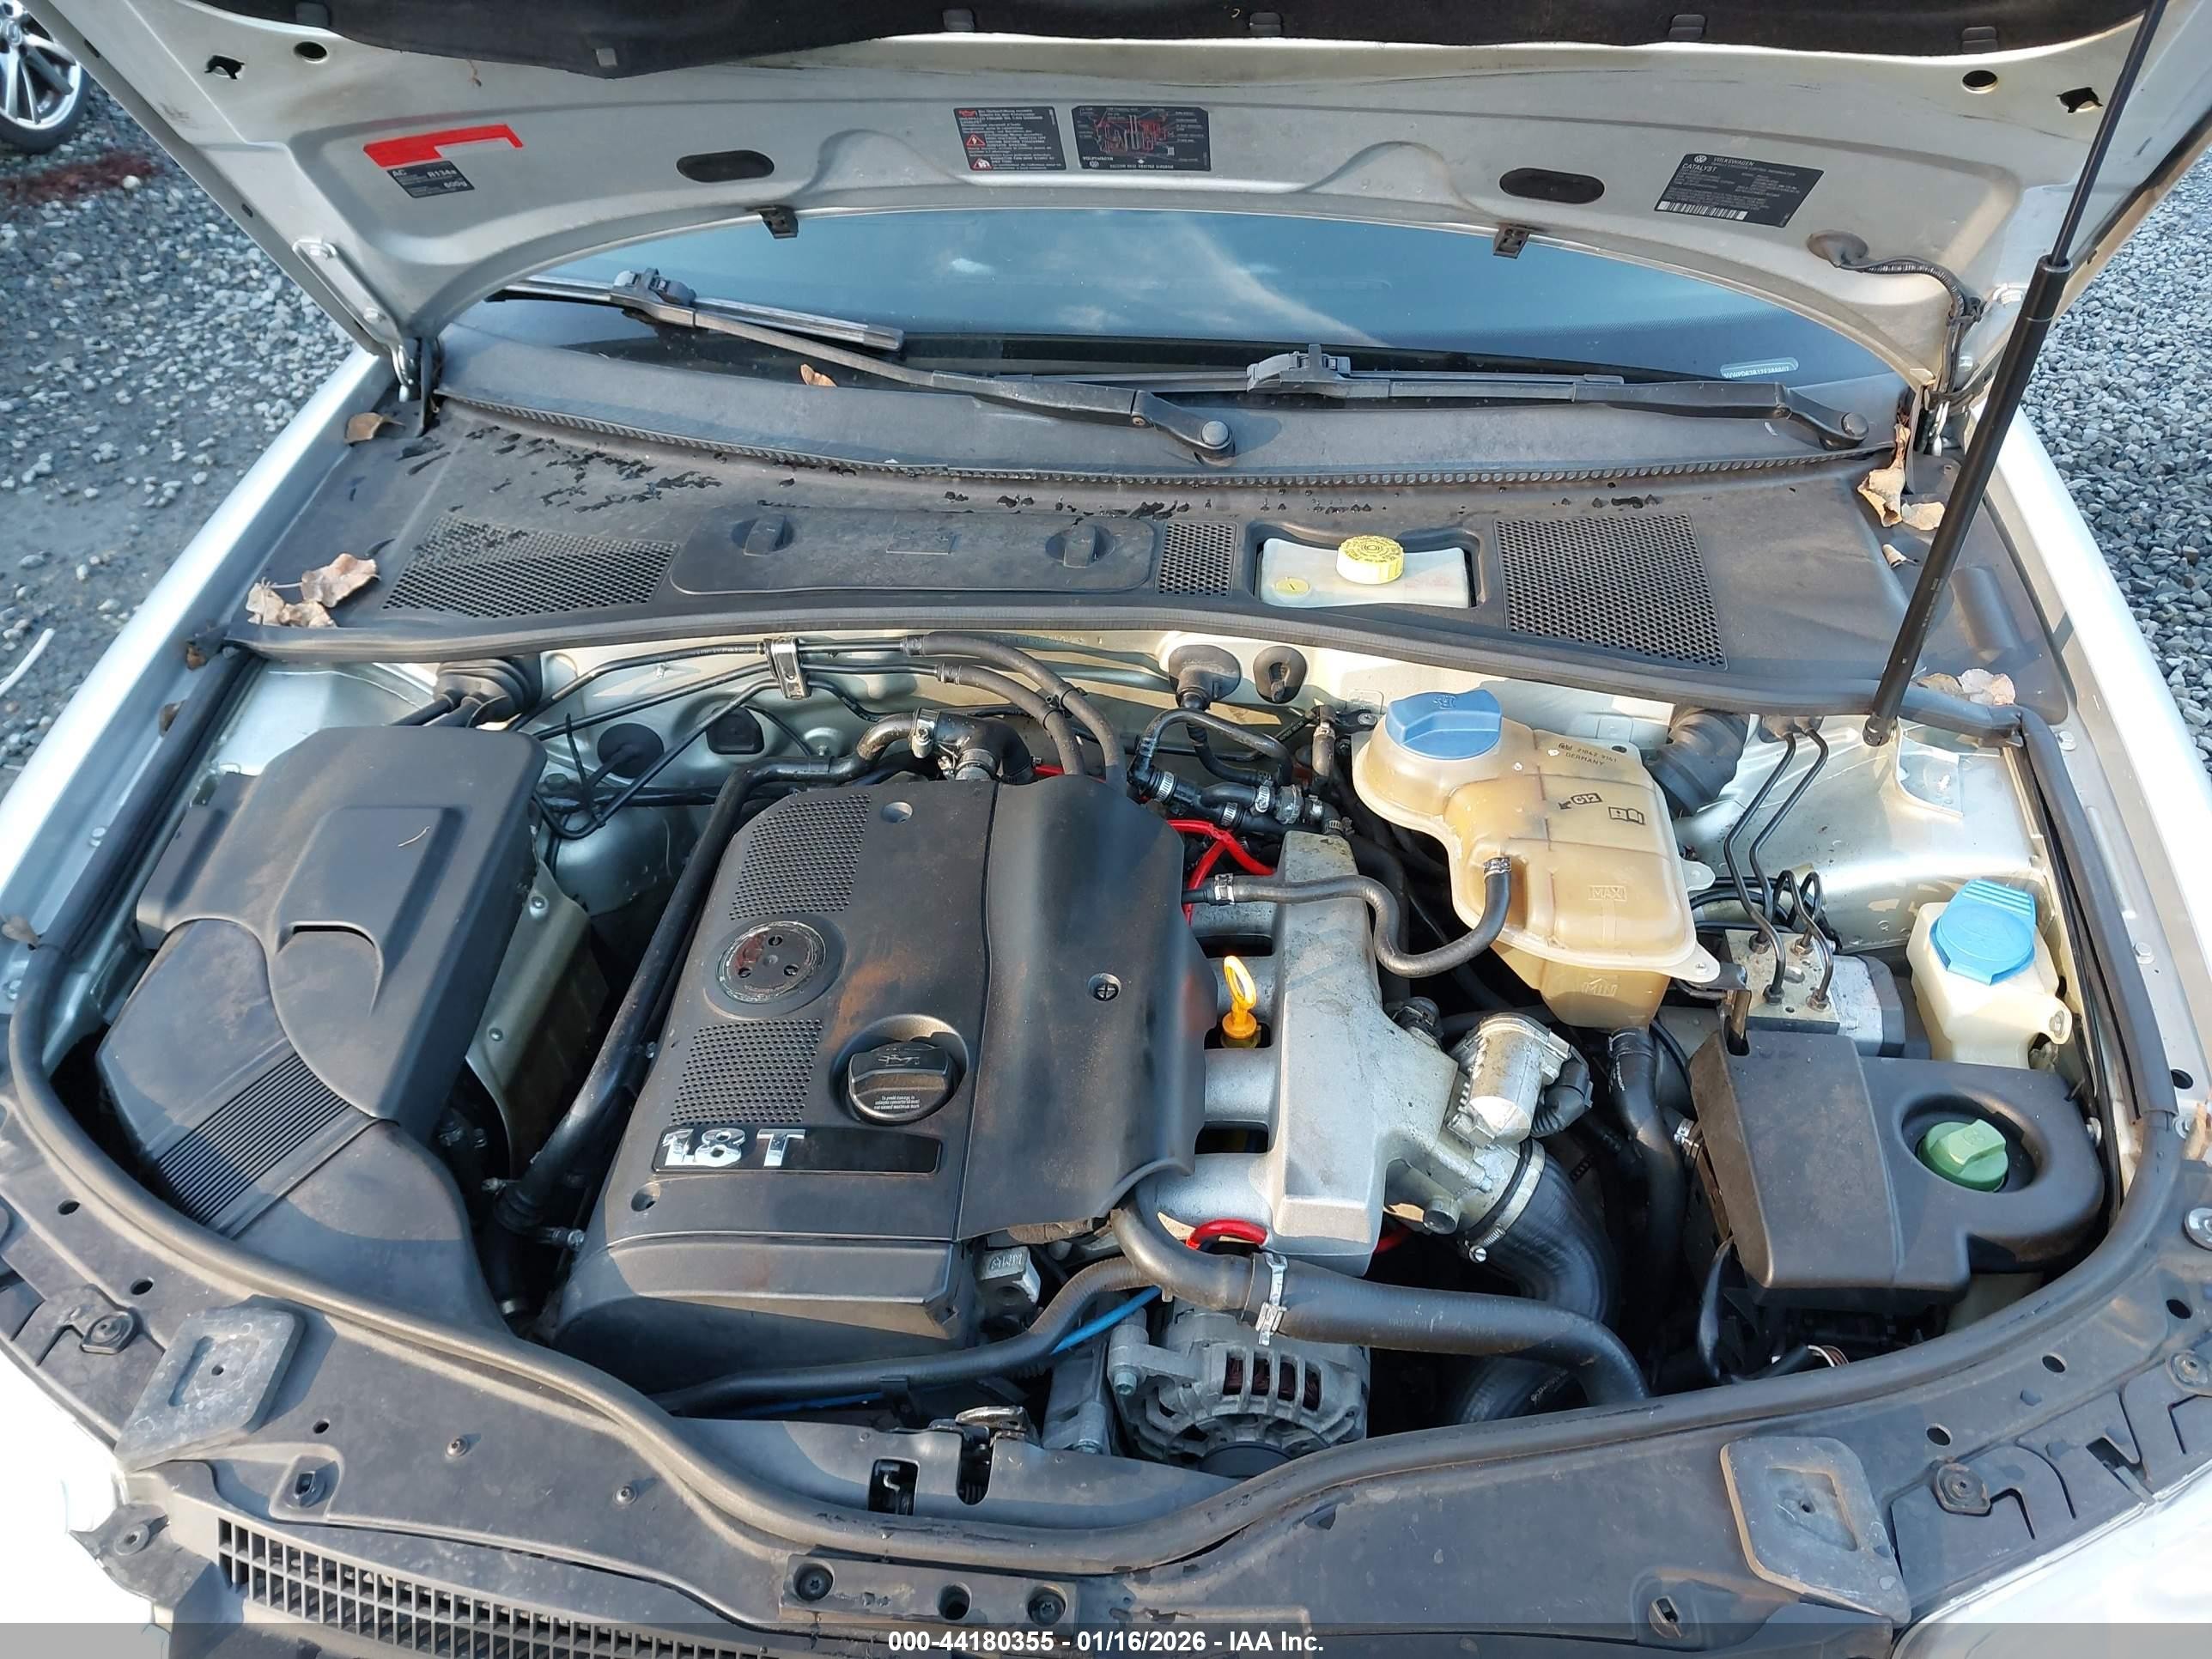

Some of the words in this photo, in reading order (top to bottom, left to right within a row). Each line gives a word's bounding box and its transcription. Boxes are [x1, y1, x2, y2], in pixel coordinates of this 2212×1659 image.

[1682, 162, 1718, 173] CATALYST
[1713, 157, 1755, 167] VOLKSWAGEN
[1566, 752, 1604, 765] GERMANY
[1592, 886, 1623, 900] MAX
[757, 1128, 806, 1167] T
